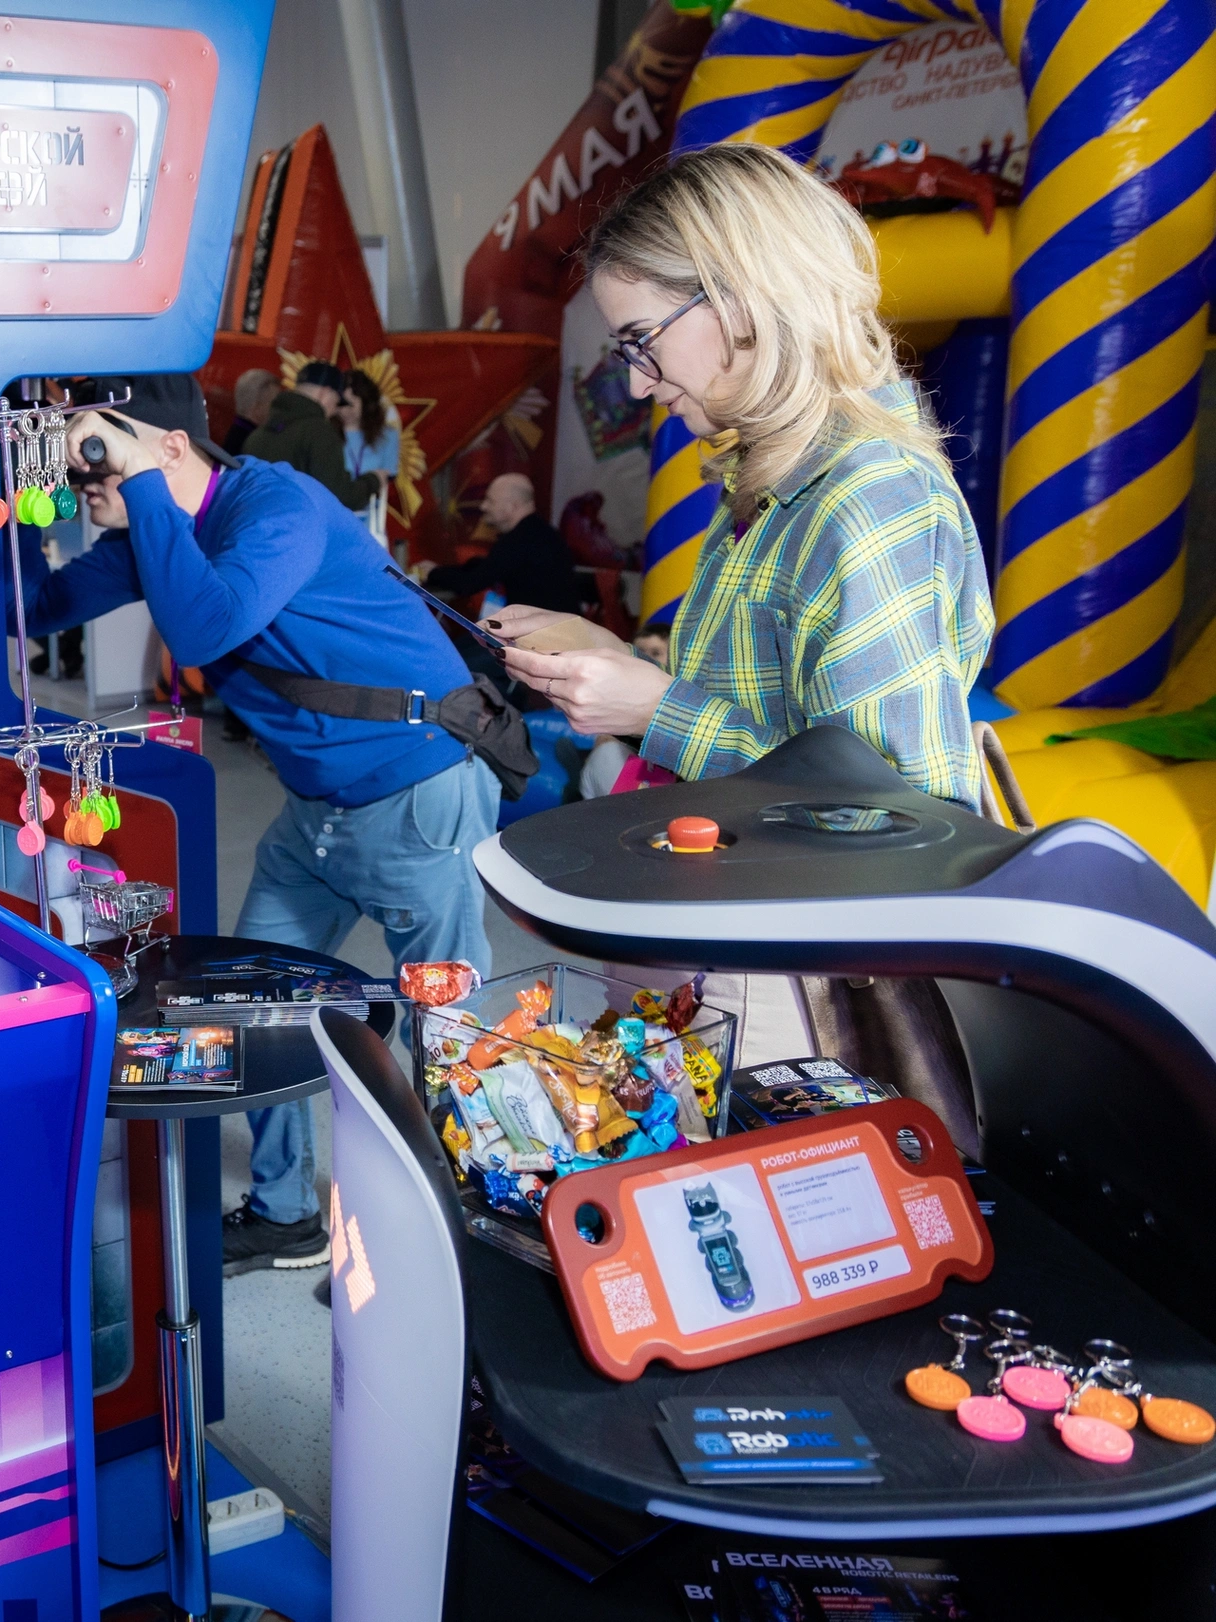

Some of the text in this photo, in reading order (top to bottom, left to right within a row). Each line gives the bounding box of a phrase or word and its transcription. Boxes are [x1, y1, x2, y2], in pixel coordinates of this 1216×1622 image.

[925, 53, 1007, 84] НАДУВ
[760, 1136, 861, 1169] РОБОТ-ОФИЦИАНТ
[812, 1271, 840, 1289] 988
[840, 1264, 866, 1283] 339
[725, 1551, 894, 1571] ВСЕЛЕННАЯ
